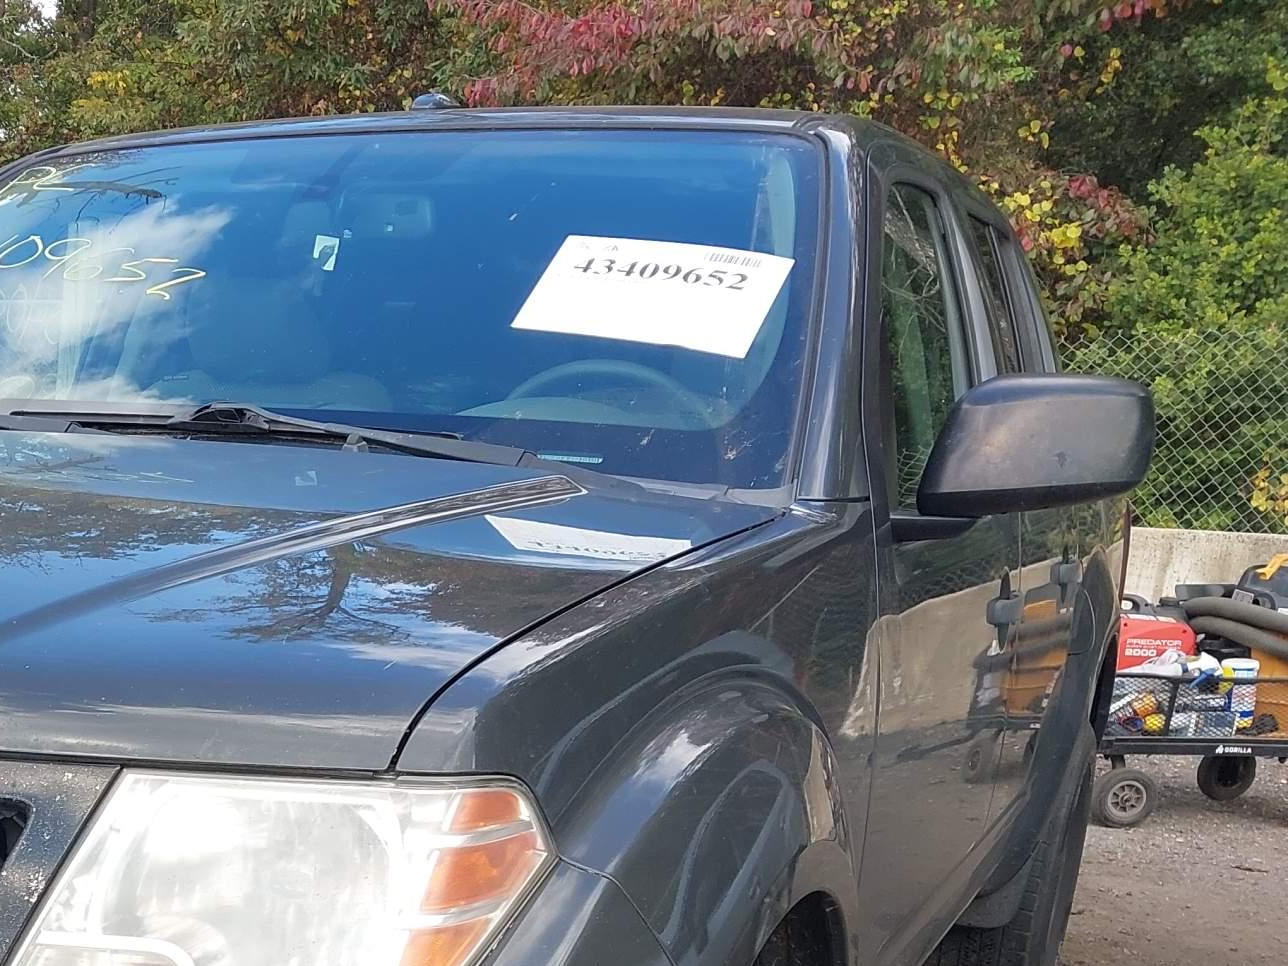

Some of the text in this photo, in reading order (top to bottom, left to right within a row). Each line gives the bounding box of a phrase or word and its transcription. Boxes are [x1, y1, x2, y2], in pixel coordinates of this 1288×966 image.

[573, 256, 749, 291] 43409652
[1126, 638, 1182, 647] PREDATOR
[1124, 648, 1158, 657] 2000
[1224, 746, 1253, 754] GORILLA
